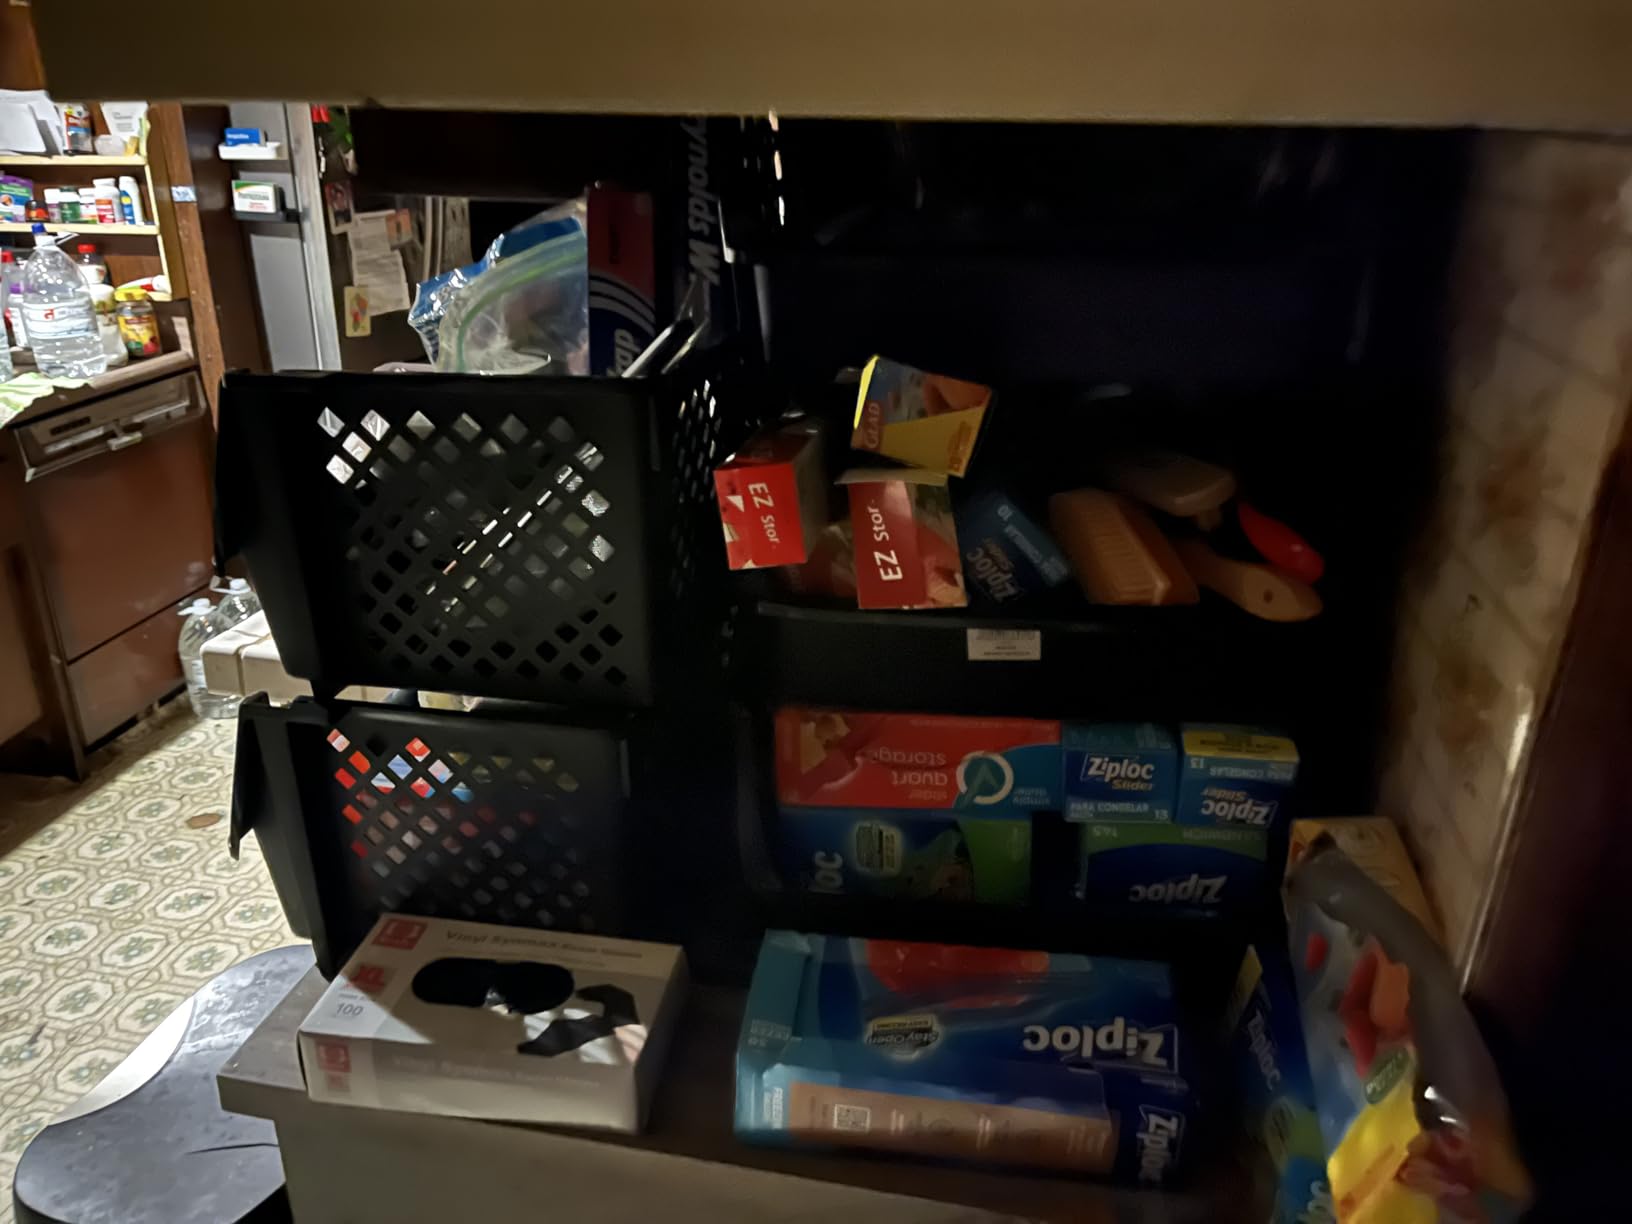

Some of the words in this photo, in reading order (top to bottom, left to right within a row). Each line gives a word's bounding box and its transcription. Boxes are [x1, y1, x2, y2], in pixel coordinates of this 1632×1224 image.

[748, 482, 775, 509] EZ
[760, 514, 782, 545] Stor
[866, 505, 890, 543] Stor
[873, 550, 904, 582] EZ
[966, 546, 1022, 603] Ziploc
[891, 770, 949, 787] quart
[1088, 757, 1155, 783] Ziploc
[1201, 799, 1270, 825] Ziploc
[1128, 872, 1229, 905] Ziploc
[335, 1001, 365, 1017] 100
[1022, 1016, 1168, 1066] Ziploc
[1136, 1112, 1180, 1183] Ziploc
